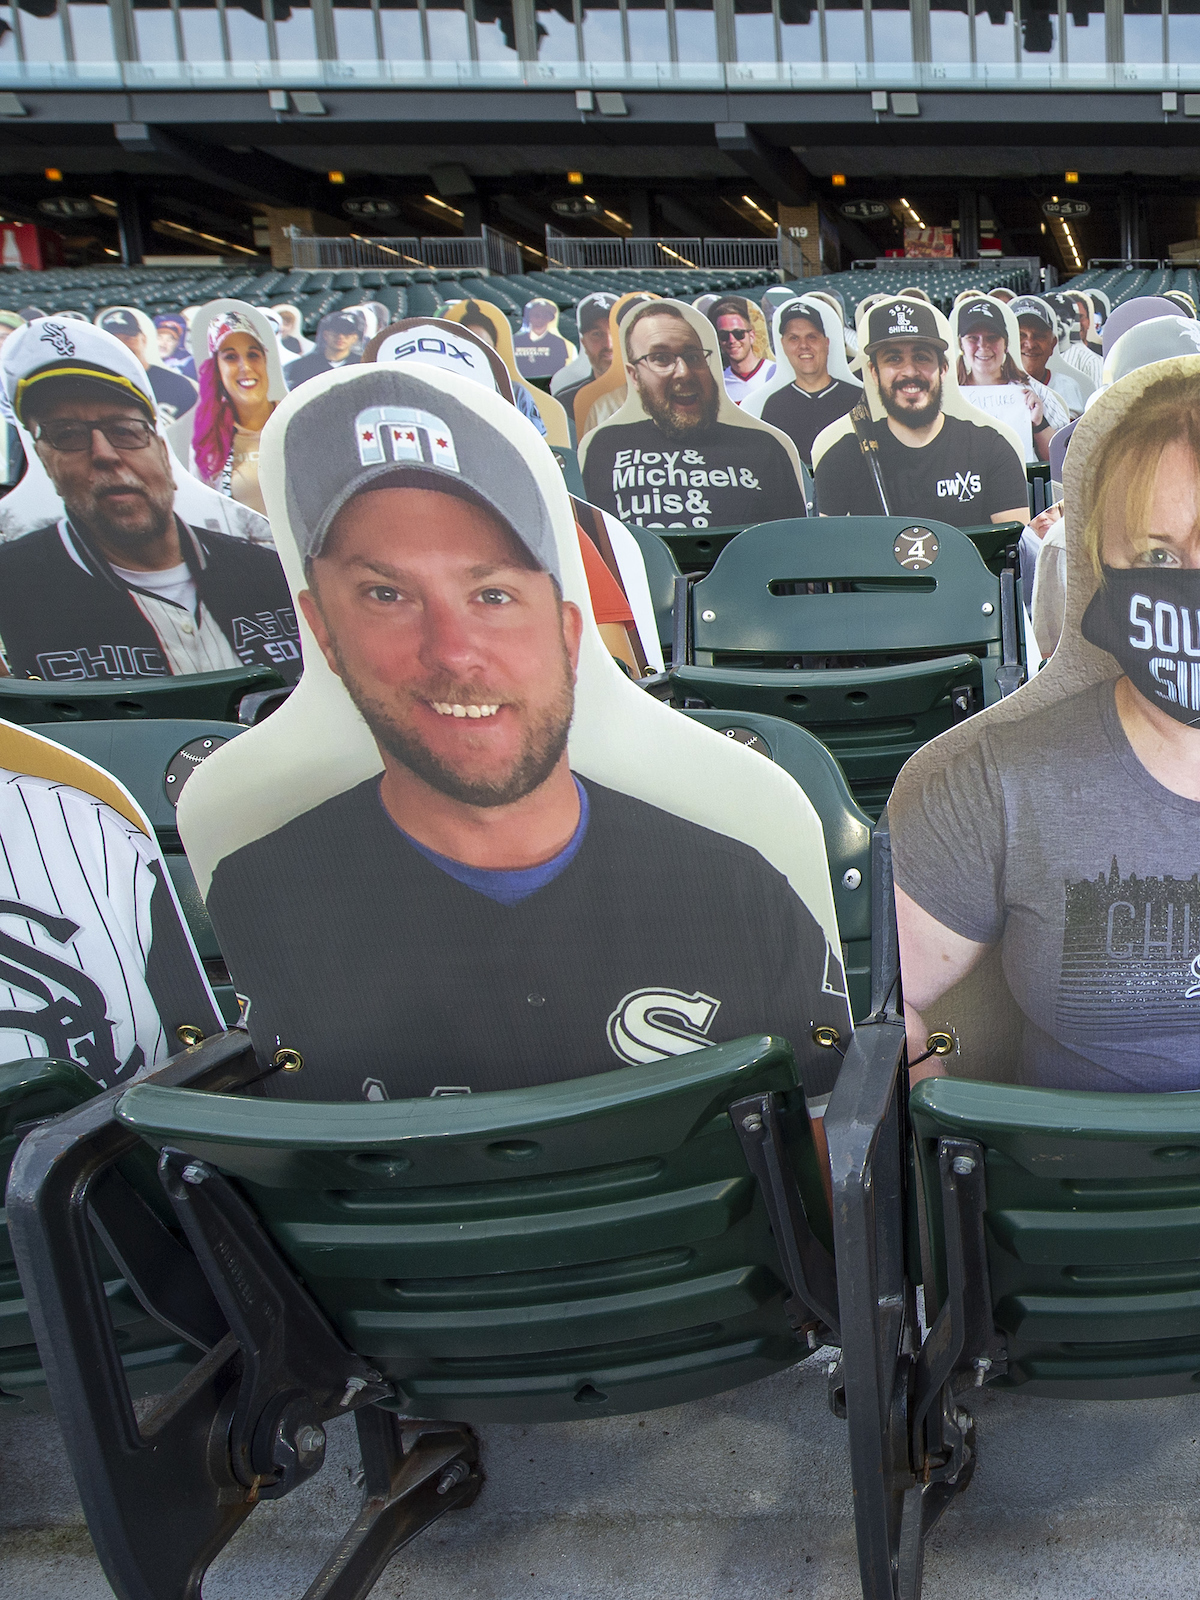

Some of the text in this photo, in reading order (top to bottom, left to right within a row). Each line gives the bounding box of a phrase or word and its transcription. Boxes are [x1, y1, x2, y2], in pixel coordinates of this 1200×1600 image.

[789, 226, 808, 237] 119
[889, 304, 914, 316] 36TH
[888, 325, 919, 334] SHIELDS
[394, 338, 475, 368] SOX
[969, 391, 1015, 409] FUTURE
[612, 465, 762, 491] Michael&
[615, 488, 712, 520] Luis&
[908, 541, 926, 559] 4
